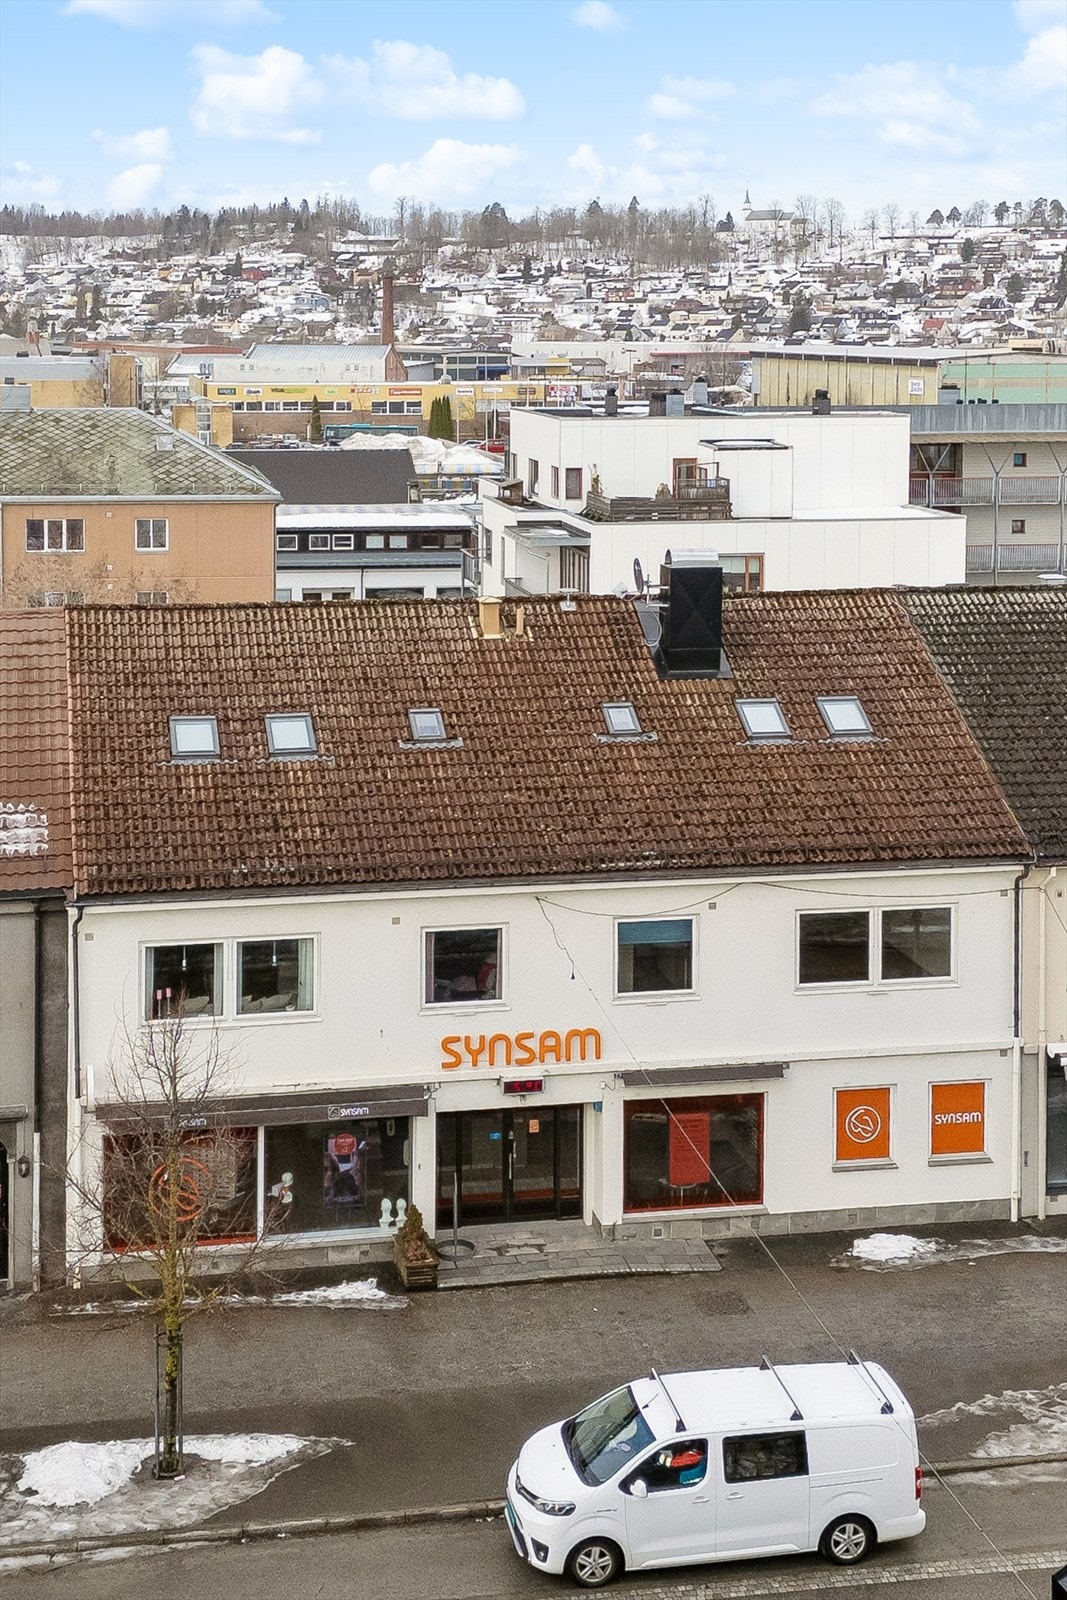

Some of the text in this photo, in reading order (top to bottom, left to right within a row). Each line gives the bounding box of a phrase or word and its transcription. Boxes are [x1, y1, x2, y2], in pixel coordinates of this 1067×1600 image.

[441, 1028, 601, 1070] SYNSAM
[340, 1106, 369, 1117] SYNSAM
[934, 1111, 982, 1125] SYNSAM
